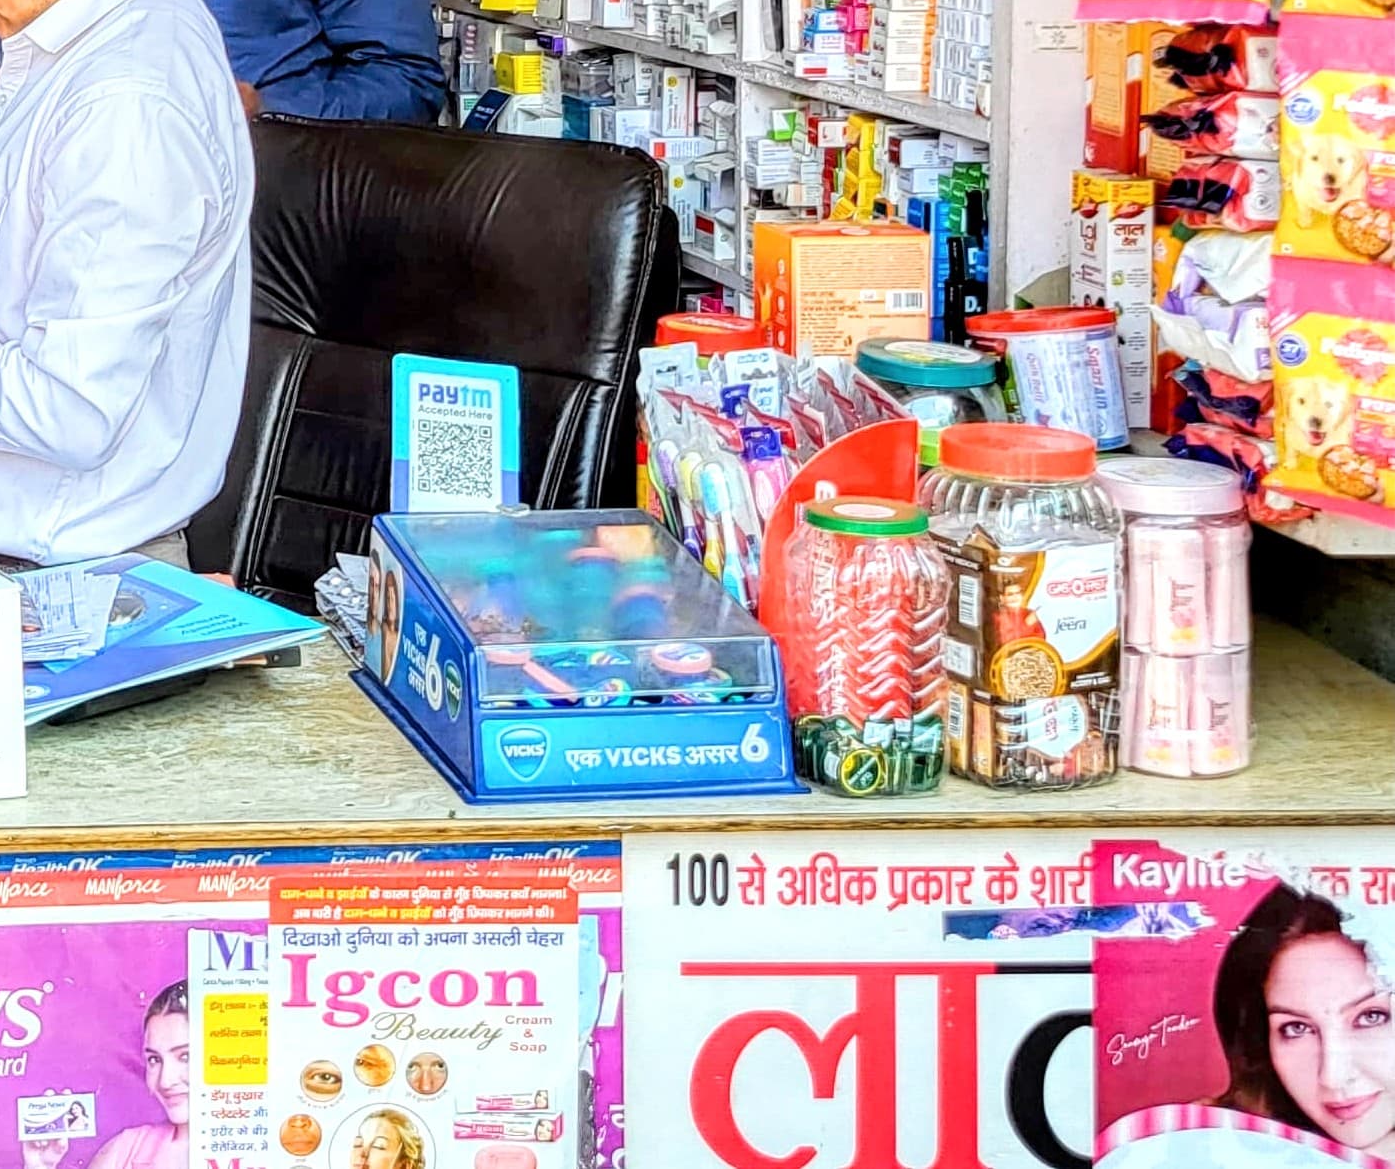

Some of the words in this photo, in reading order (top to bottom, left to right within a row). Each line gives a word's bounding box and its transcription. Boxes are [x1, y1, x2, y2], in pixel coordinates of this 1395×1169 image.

[417, 383, 493, 409] paytm
[417, 404, 466, 419] Accepted
[467, 409, 494, 421] Here
[1053, 616, 1088, 634] Jeera
[403, 634, 427, 669] VICKS
[426, 635, 444, 712] 6
[503, 742, 545, 758] VICKS
[564, 747, 602, 769] एक
[605, 745, 681, 769] VICKS
[684, 745, 740, 767] असर
[740, 723, 769, 763] 6
[85, 872, 166, 901] MANforce
[666, 852, 730, 907] 100
[736, 852, 766, 906] से
[777, 851, 878, 907] अधिक
[886, 866, 974, 912] प्रकार
[984, 852, 1020, 906] के
[282, 927, 342, 948] दिखाओ
[346, 926, 393, 953] दुनिया
[396, 926, 420, 947] को
[424, 929, 468, 947] अपना
[473, 926, 521, 948] असली
[525, 928, 564, 948] चेहरा
[281, 952, 545, 1029] Igcon
[369, 1011, 503, 1051] Beauty
[504, 1013, 554, 1028] Cream
[522, 1028, 534, 1039] &
[509, 1039, 549, 1055] Soap
